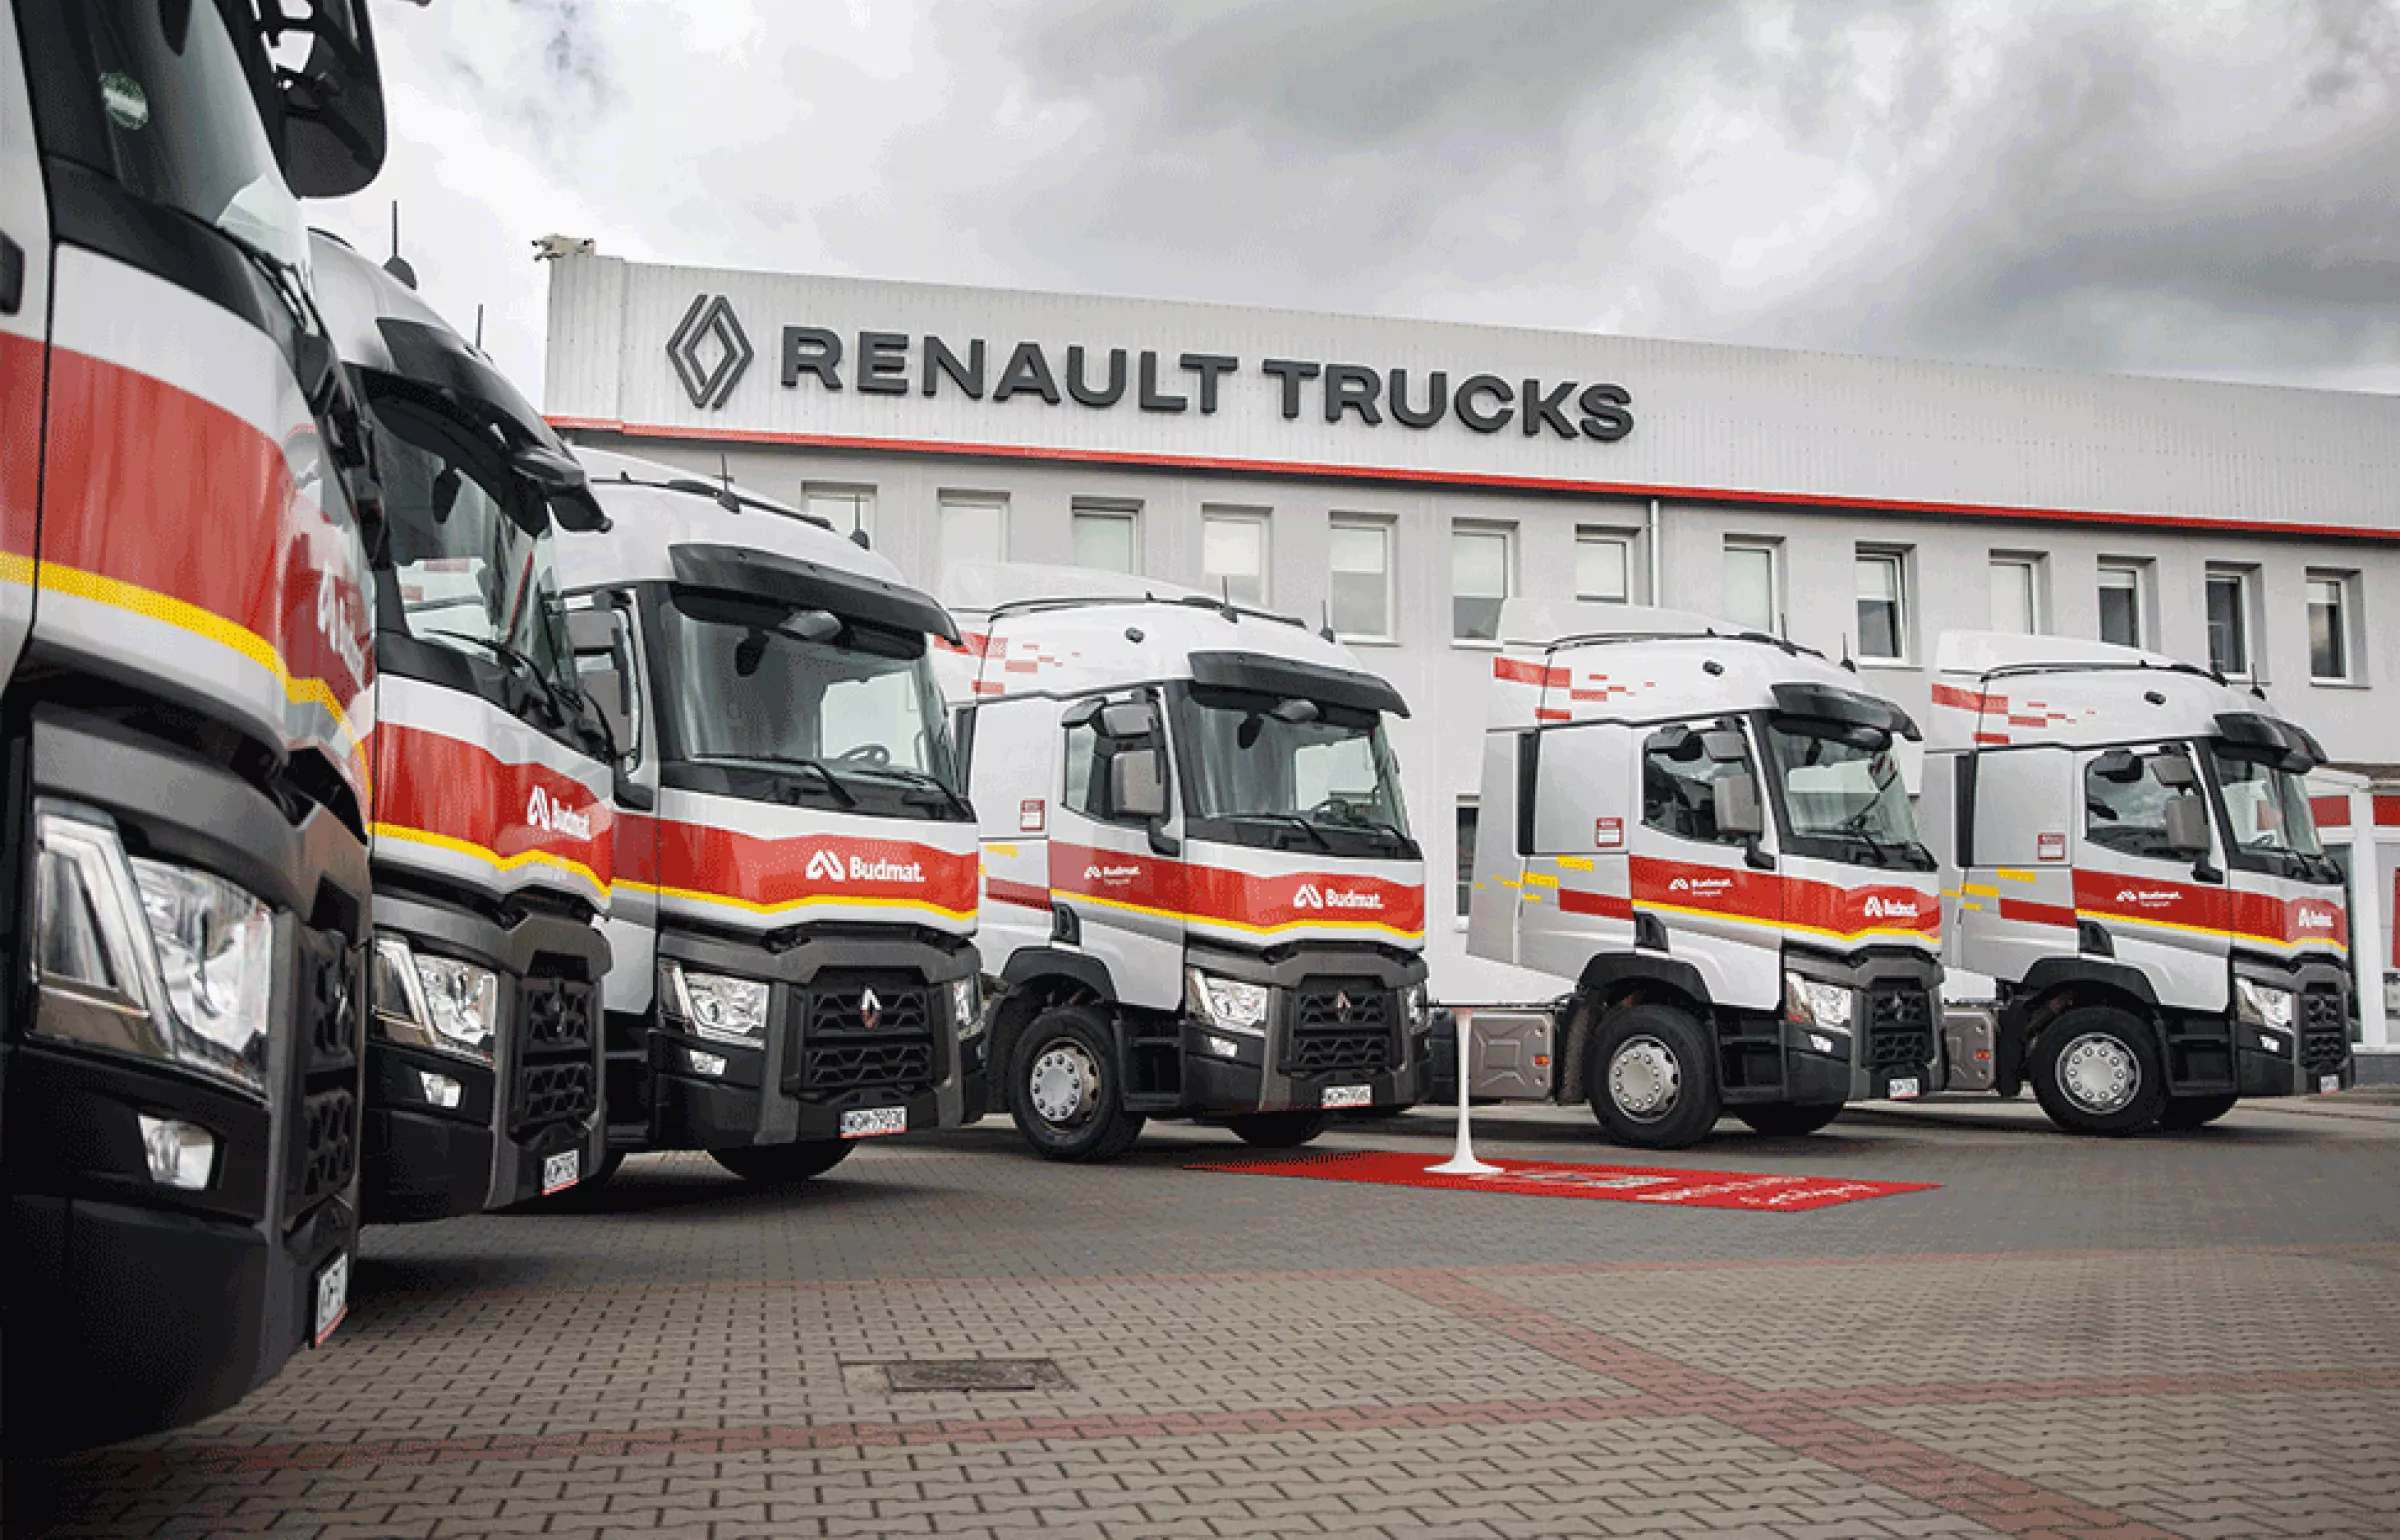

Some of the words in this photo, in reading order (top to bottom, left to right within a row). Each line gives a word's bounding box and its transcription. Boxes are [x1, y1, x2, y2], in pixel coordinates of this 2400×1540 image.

[780, 325, 1238, 414] RENAULT
[1262, 358, 1635, 441] TRUCKS
[849, 856, 926, 882] Budmat.
